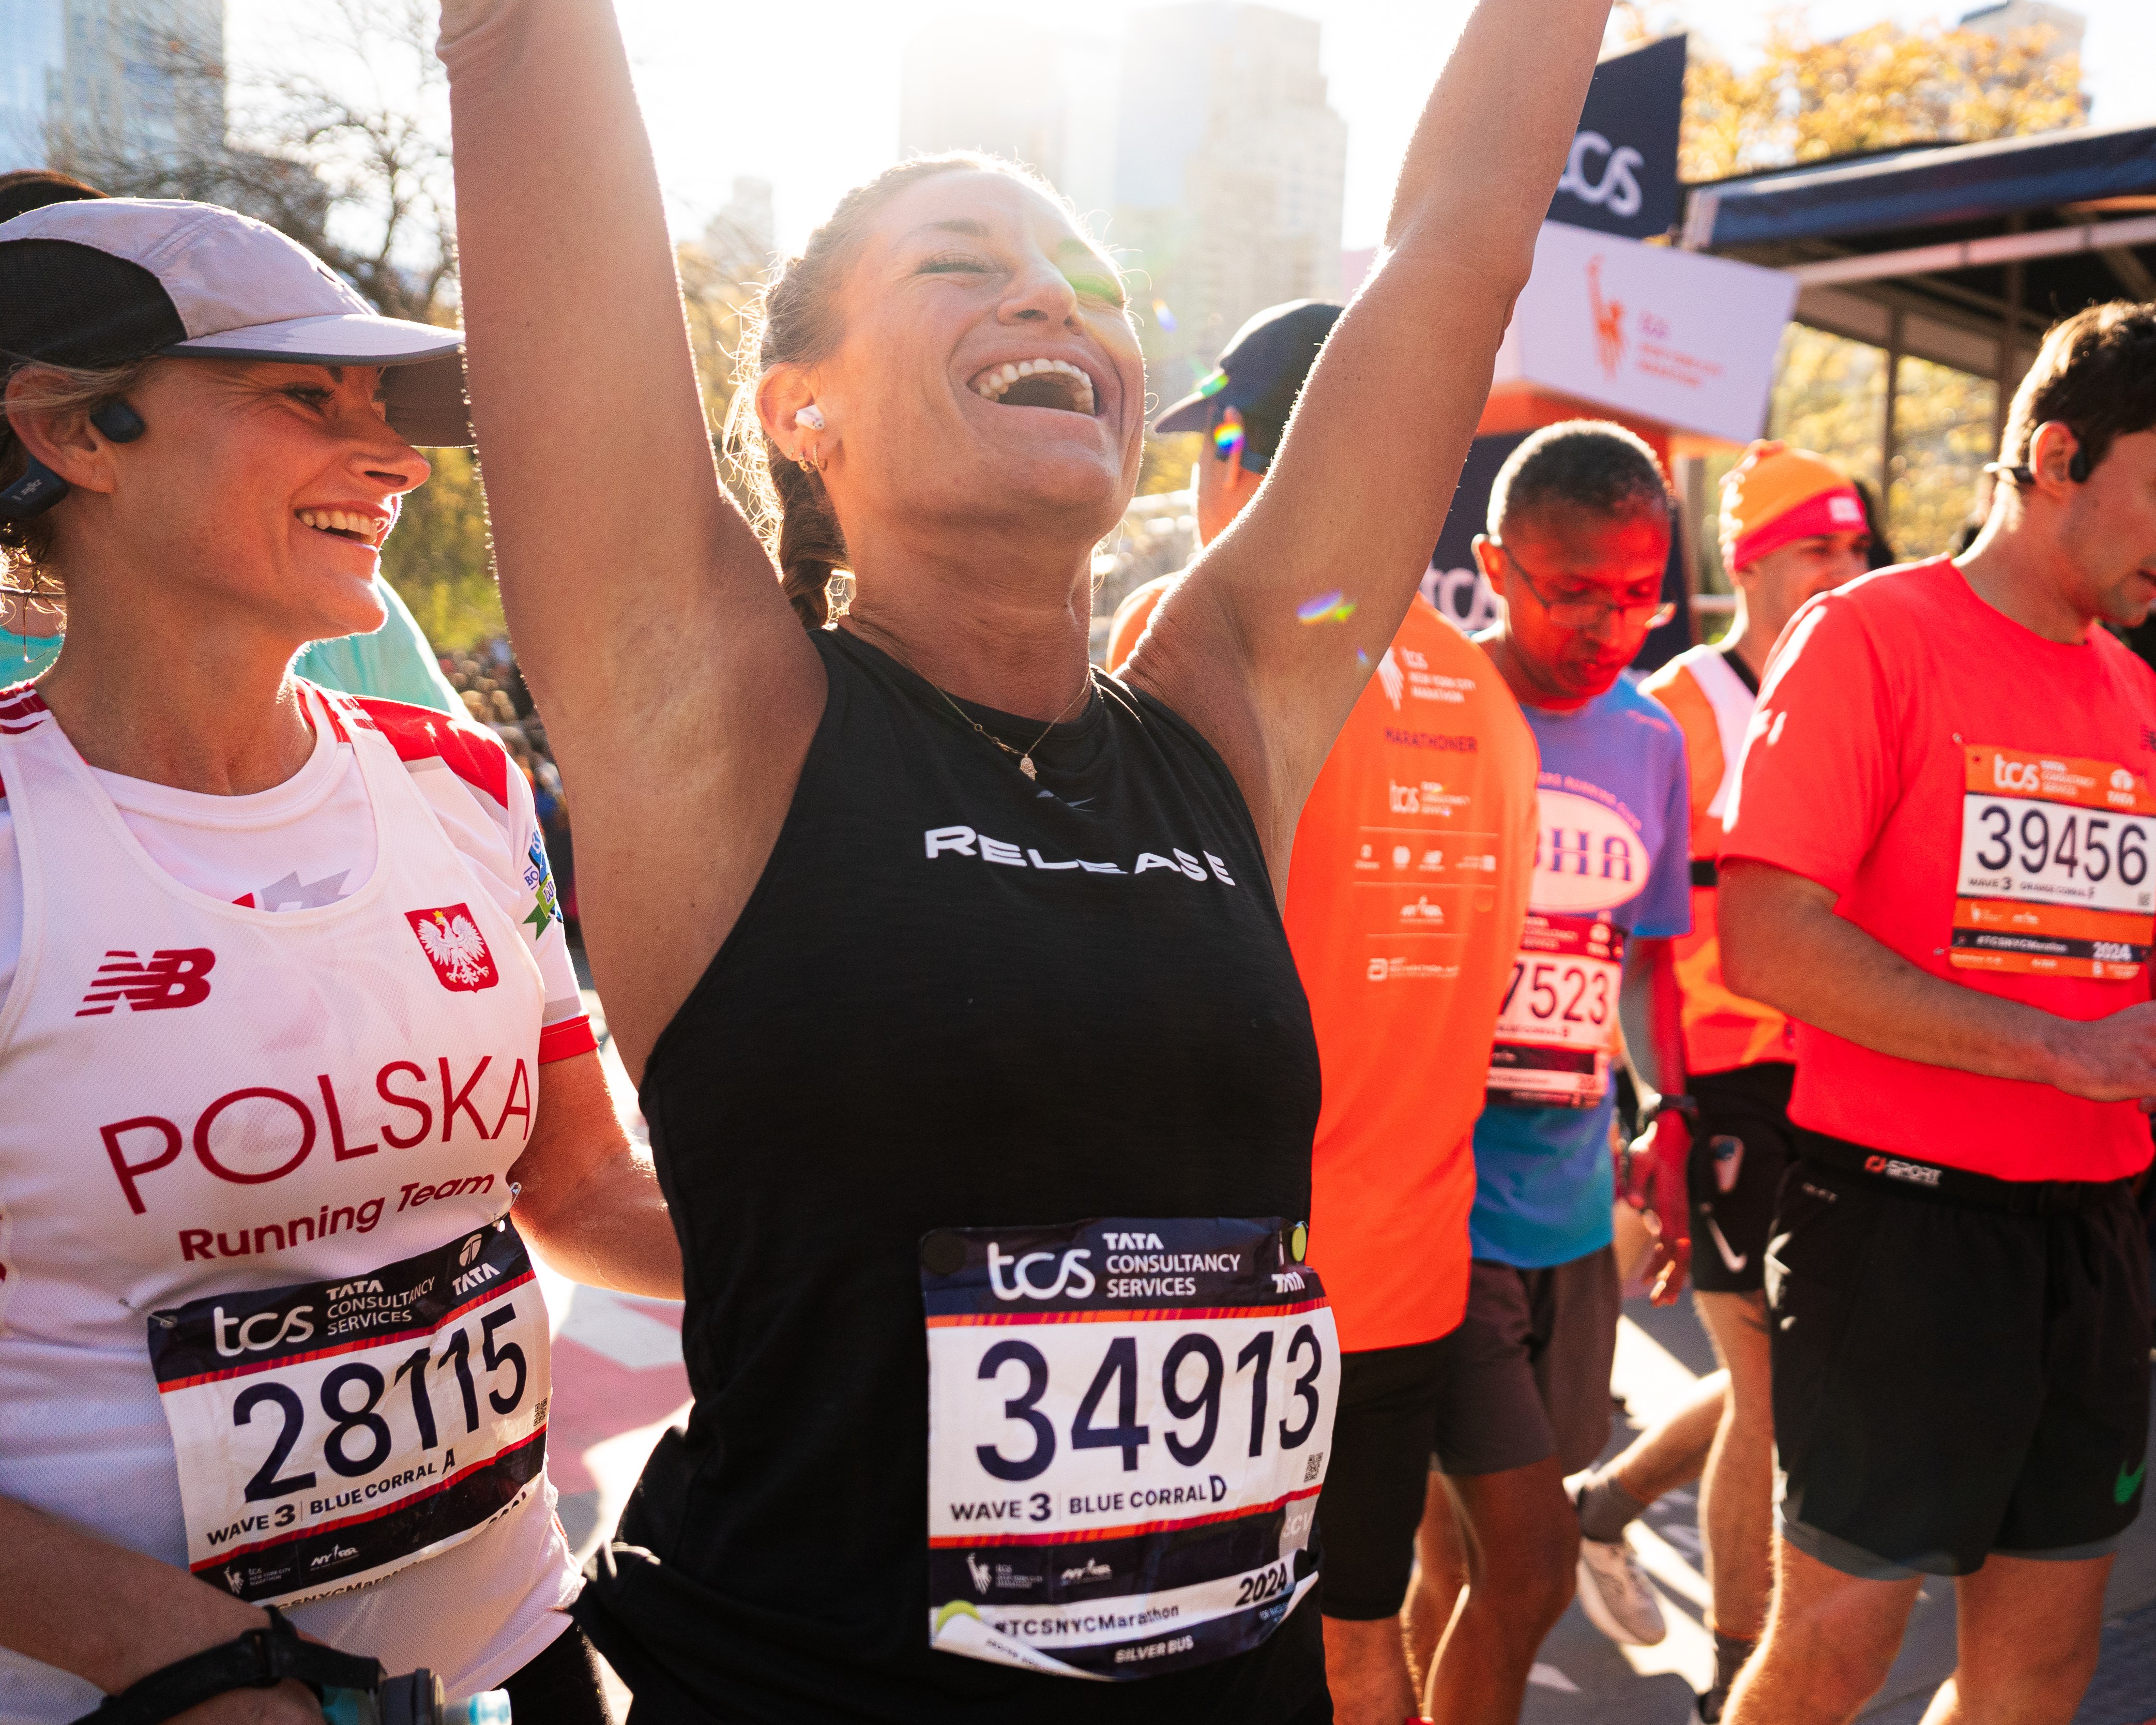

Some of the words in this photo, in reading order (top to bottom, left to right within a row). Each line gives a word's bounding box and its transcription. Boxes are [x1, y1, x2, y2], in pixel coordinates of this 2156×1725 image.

[1557, 130, 1645, 218] cs
[1994, 753, 2040, 791] tcs
[1389, 779, 1419, 813] tcs
[924, 825, 1236, 886] RELEASE
[1976, 804, 2148, 886] 39456
[2002, 877, 2011, 890] 3
[2093, 941, 2132, 961] 2024
[99, 1056, 530, 1215] POLSKA
[179, 1197, 385, 1262] Running
[396, 1174, 495, 1213] Team
[1102, 1232, 1164, 1250] TATA
[452, 1262, 500, 1296] TATA
[987, 1242, 1096, 1301] tcs
[1106, 1254, 1241, 1274] CONSULTANCY
[1272, 1271, 1304, 1293] TATA
[326, 1279, 384, 1300] TATA
[327, 1276, 435, 1319] CONSULTANCY
[1106, 1277, 1196, 1298] SERVICES
[213, 1305, 314, 1357] tcs
[327, 1310, 412, 1336] SERVICES
[233, 1302, 527, 1504] 28115
[976, 1324, 1323, 1482] 34913
[207, 1515, 269, 1546] WAVE
[275, 1503, 296, 1527] 3
[310, 1489, 363, 1515] BLUE
[365, 1462, 437, 1498] CORRAL
[442, 1448, 456, 1474] A
[950, 1501, 1022, 1521] WAVE
[1029, 1493, 1052, 1522] 3
[1069, 1493, 1123, 1514] BLUE
[1130, 1484, 1206, 1508] CORRAL
[1209, 1474, 1227, 1503] D
[1235, 1562, 1287, 1607] 2024
[1114, 1641, 1166, 1664] SILVER
[1167, 1635, 1194, 1655] BUS
